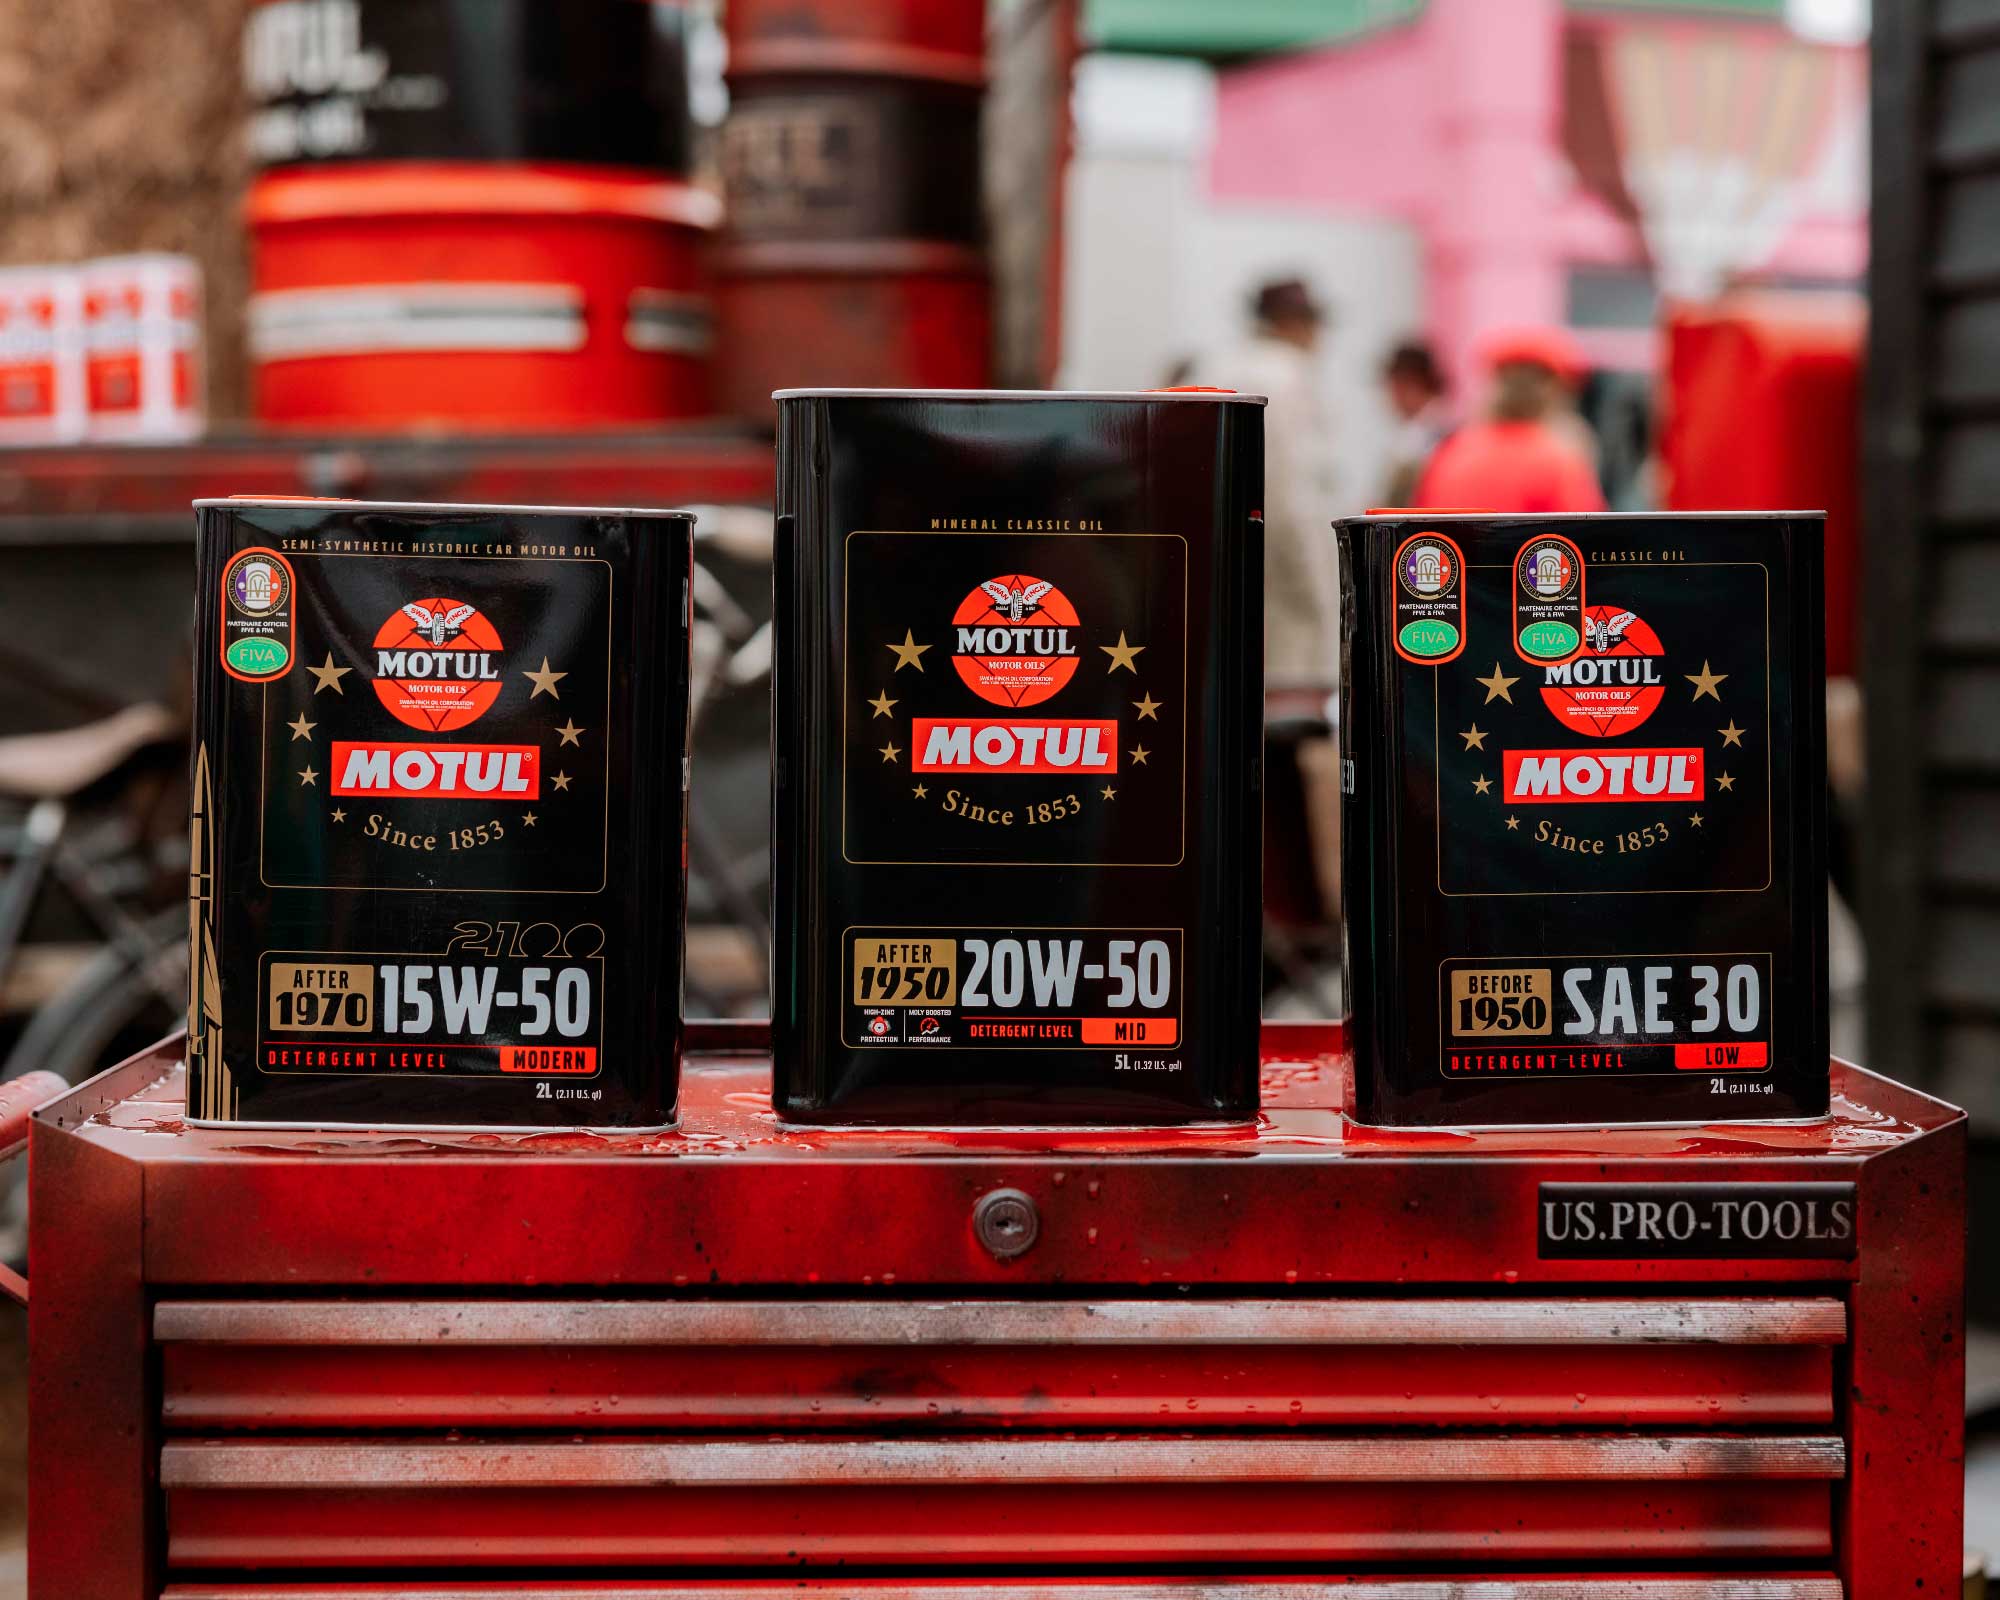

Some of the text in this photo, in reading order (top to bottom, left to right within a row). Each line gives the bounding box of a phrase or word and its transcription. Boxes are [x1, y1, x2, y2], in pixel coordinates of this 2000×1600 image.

[931, 519, 1103, 531] MINERAL CLASSIC OIL
[282, 539, 597, 557] SEMI-SYNTHETIC HISTORIC CAR MOTOR OIL
[1591, 551, 1685, 561] CLASSIC OIL
[988, 584, 1046, 601] SWAN FINCH
[410, 607, 468, 625] SWAN FINCH
[1609, 615, 1630, 632] FINCH
[956, 627, 1077, 655] MOTUL
[1412, 631, 1447, 643] FIVA
[1532, 632, 1567, 645] FIVA
[240, 649, 276, 662] FIVA
[377, 651, 499, 679] MOTUL
[988, 661, 1046, 670] MOTOR OILS
[1545, 659, 1661, 685] MOTUL
[408, 684, 467, 694] MOTOR OILS
[1575, 691, 1631, 700] MOTOR OILS
[942, 789, 1082, 826] Since 1853
[363, 814, 505, 851] Since 1853
[1535, 820, 1670, 855] Since 1853
[446, 920, 606, 958] 2100
[876, 944, 933, 964] AFTER
[292, 968, 349, 990] AFTER
[961, 939, 1171, 1008] 20W-50
[860, 966, 951, 1001] 1950
[1468, 975, 1533, 995] BEFORE
[275, 992, 368, 1027] 1970
[380, 964, 591, 1037] 15W-50
[1563, 964, 1761, 1036] SAE 30
[1458, 996, 1547, 1032] 1950
[970, 1024, 1074, 1038] DETERGENT LEVEL
[1114, 1023, 1146, 1041] MID
[268, 1050, 447, 1068] DETERGENT LEVEL
[512, 1049, 587, 1071] MODERN
[1114, 1054, 1182, 1072] 5L (1.32 U.S. gal)
[1452, 1053, 1626, 1071] DETERGENT LEVEL
[1705, 1046, 1741, 1066] LOW
[536, 1082, 553, 1099] 2L
[556, 1089, 574, 1100] (2.11
[576, 1090, 590, 1099] U.S.
[1710, 1078, 1727, 1094] 2L
[1729, 1084, 1747, 1095] (2.11
[1749, 1084, 1762, 1093] U.S.
[1543, 1200, 1851, 1241] US.PRO-TOOLS
